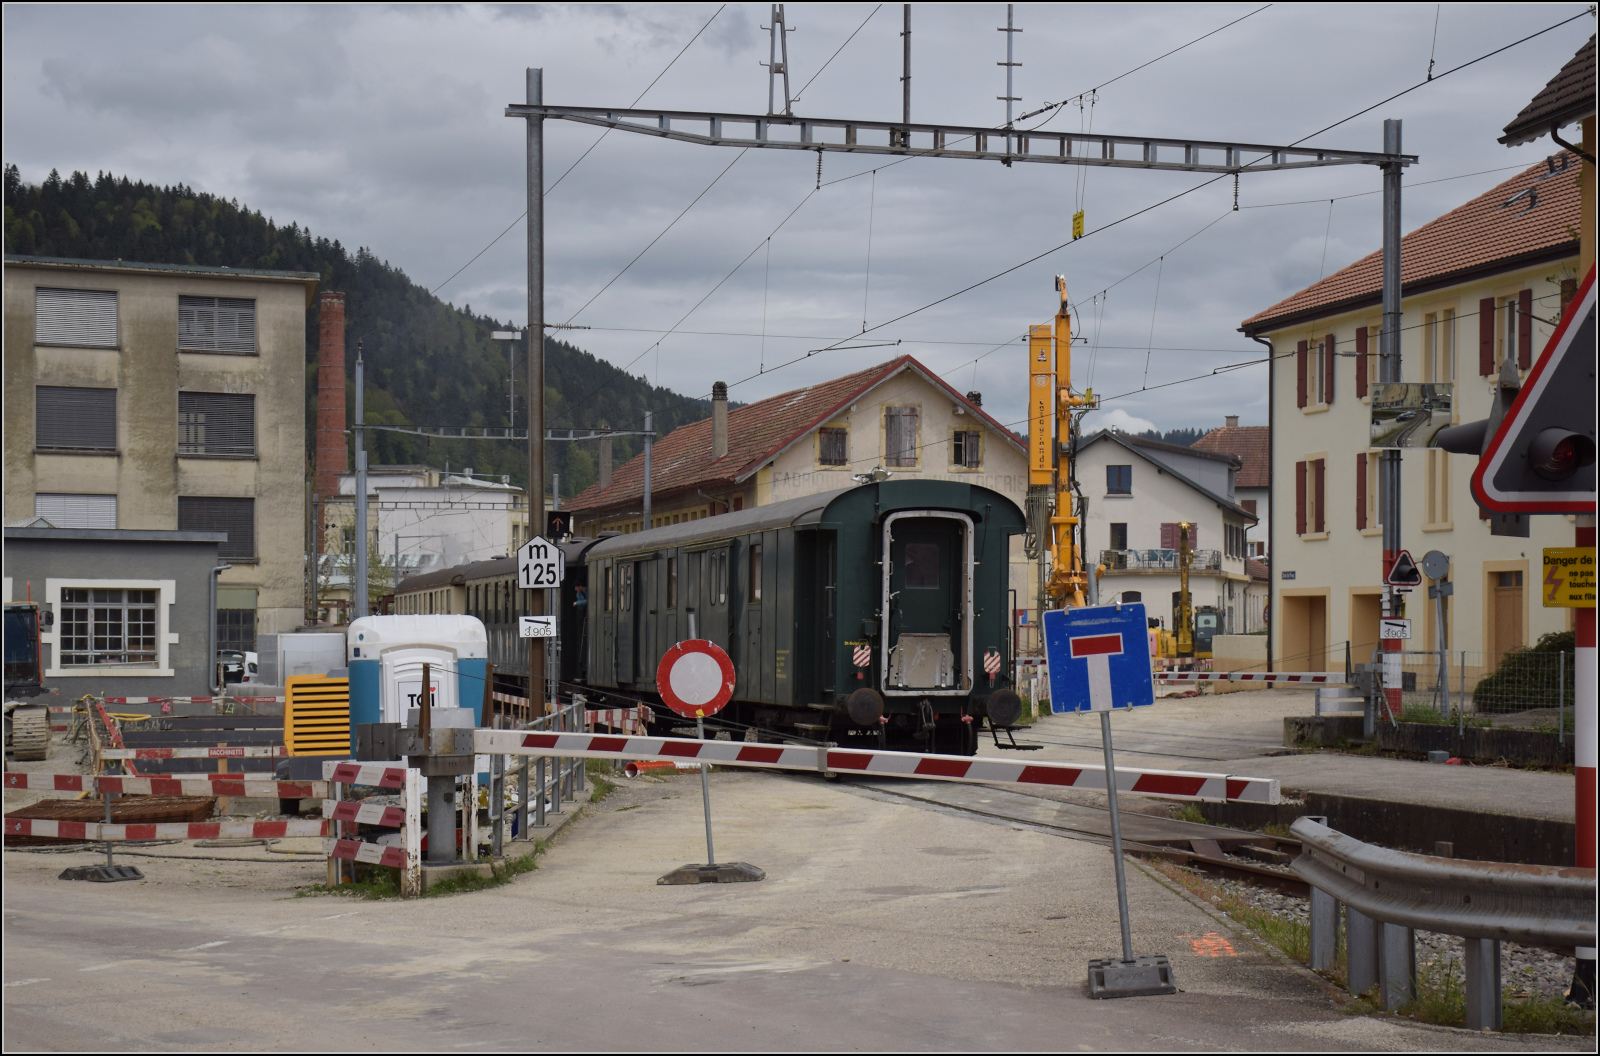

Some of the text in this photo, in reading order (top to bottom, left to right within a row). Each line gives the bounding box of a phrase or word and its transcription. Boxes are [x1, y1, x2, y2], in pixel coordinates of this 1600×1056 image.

[529, 544, 548, 559] m
[1543, 555, 1578, 567] Danger
[1580, 555, 1592, 565] de
[522, 563, 556, 585] 125
[524, 627, 552, 637] 3.905
[1384, 629, 1408, 638] 3.905
[160, 702, 171, 712] 26
